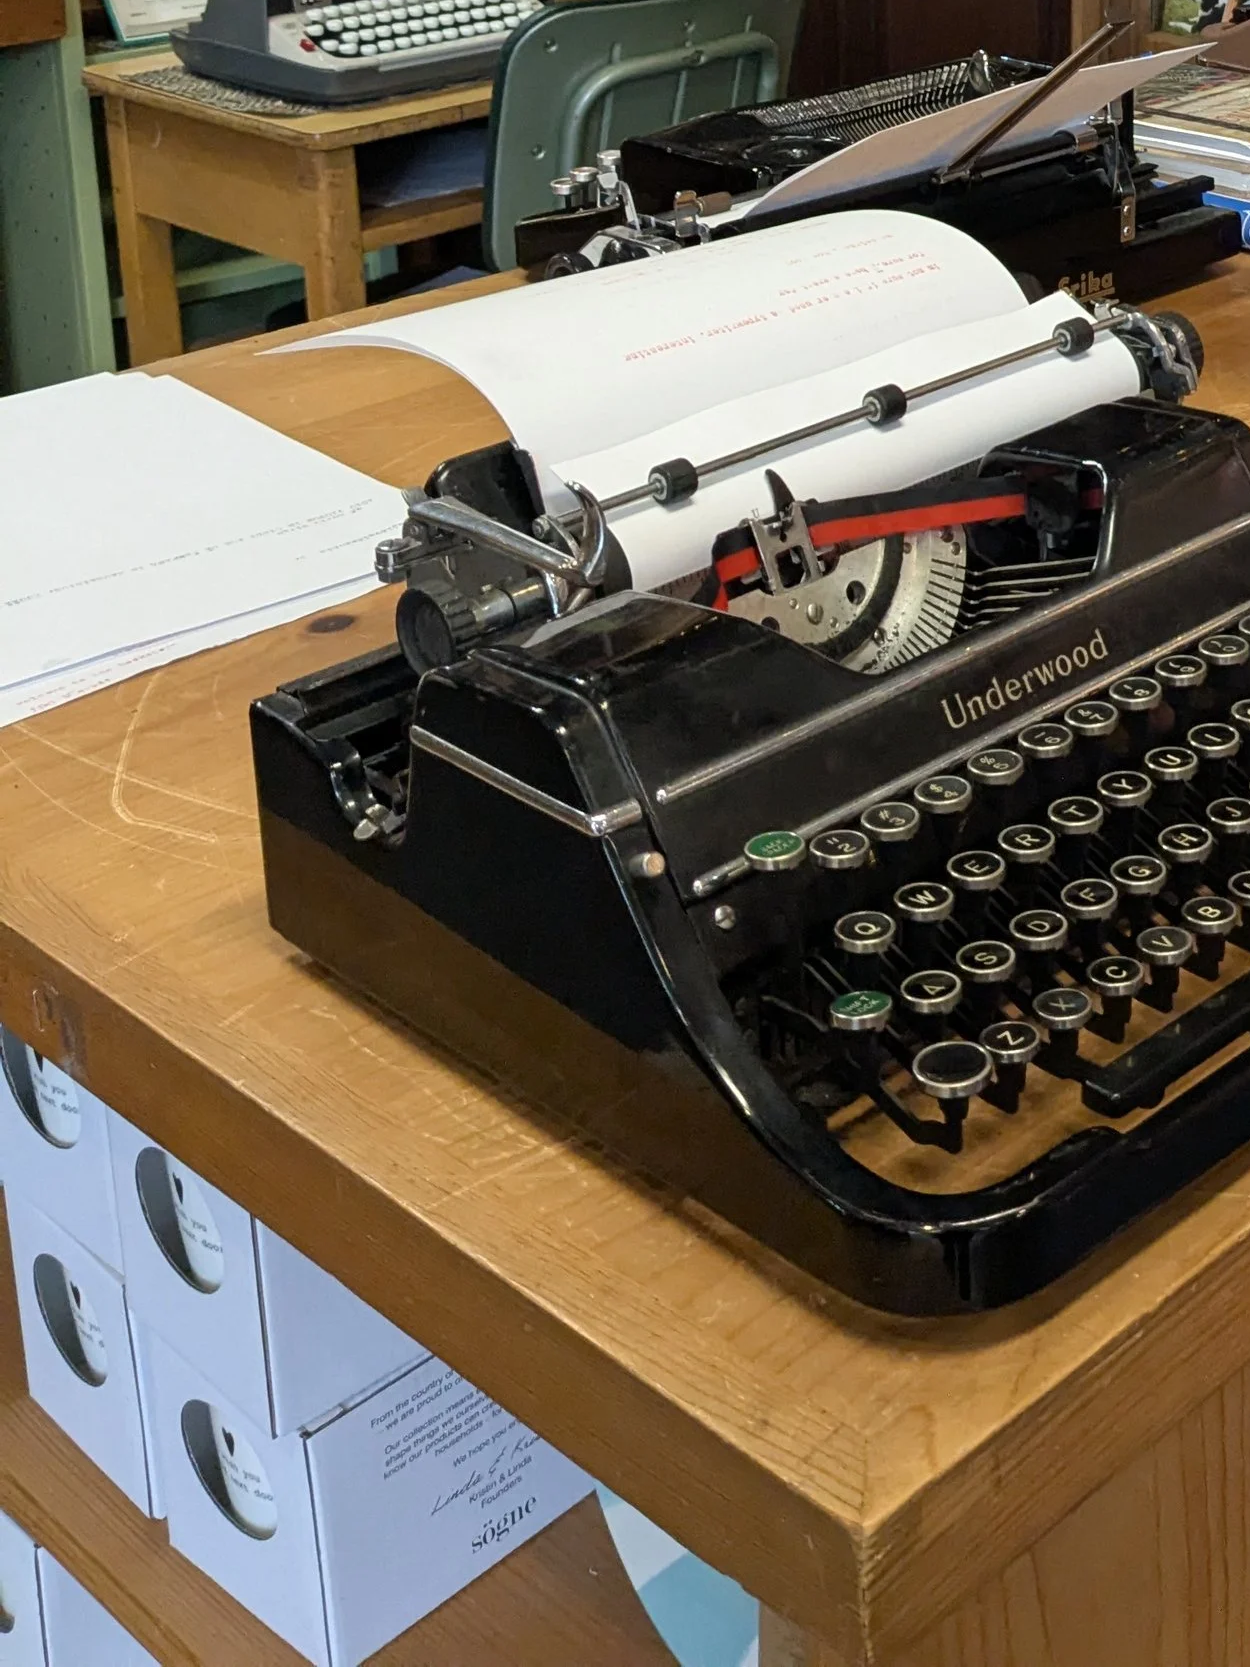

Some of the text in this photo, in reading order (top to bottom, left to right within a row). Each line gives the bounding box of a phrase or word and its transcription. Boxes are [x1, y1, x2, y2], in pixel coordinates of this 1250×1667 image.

[940, 627, 1109, 729] Underwood
[370, 1375, 443, 1428] From the country
[416, 1388, 443, 1413] proud
[403, 1411, 444, 1444] collection
[413, 1425, 440, 1448] things
[425, 1422, 463, 1454] products
[434, 1421, 483, 1457] households
[468, 1439, 490, 1460] hope
[469, 1455, 533, 1504] Kristin Linda
[481, 1476, 523, 1509] Founders
[471, 1496, 537, 1555] sögne
